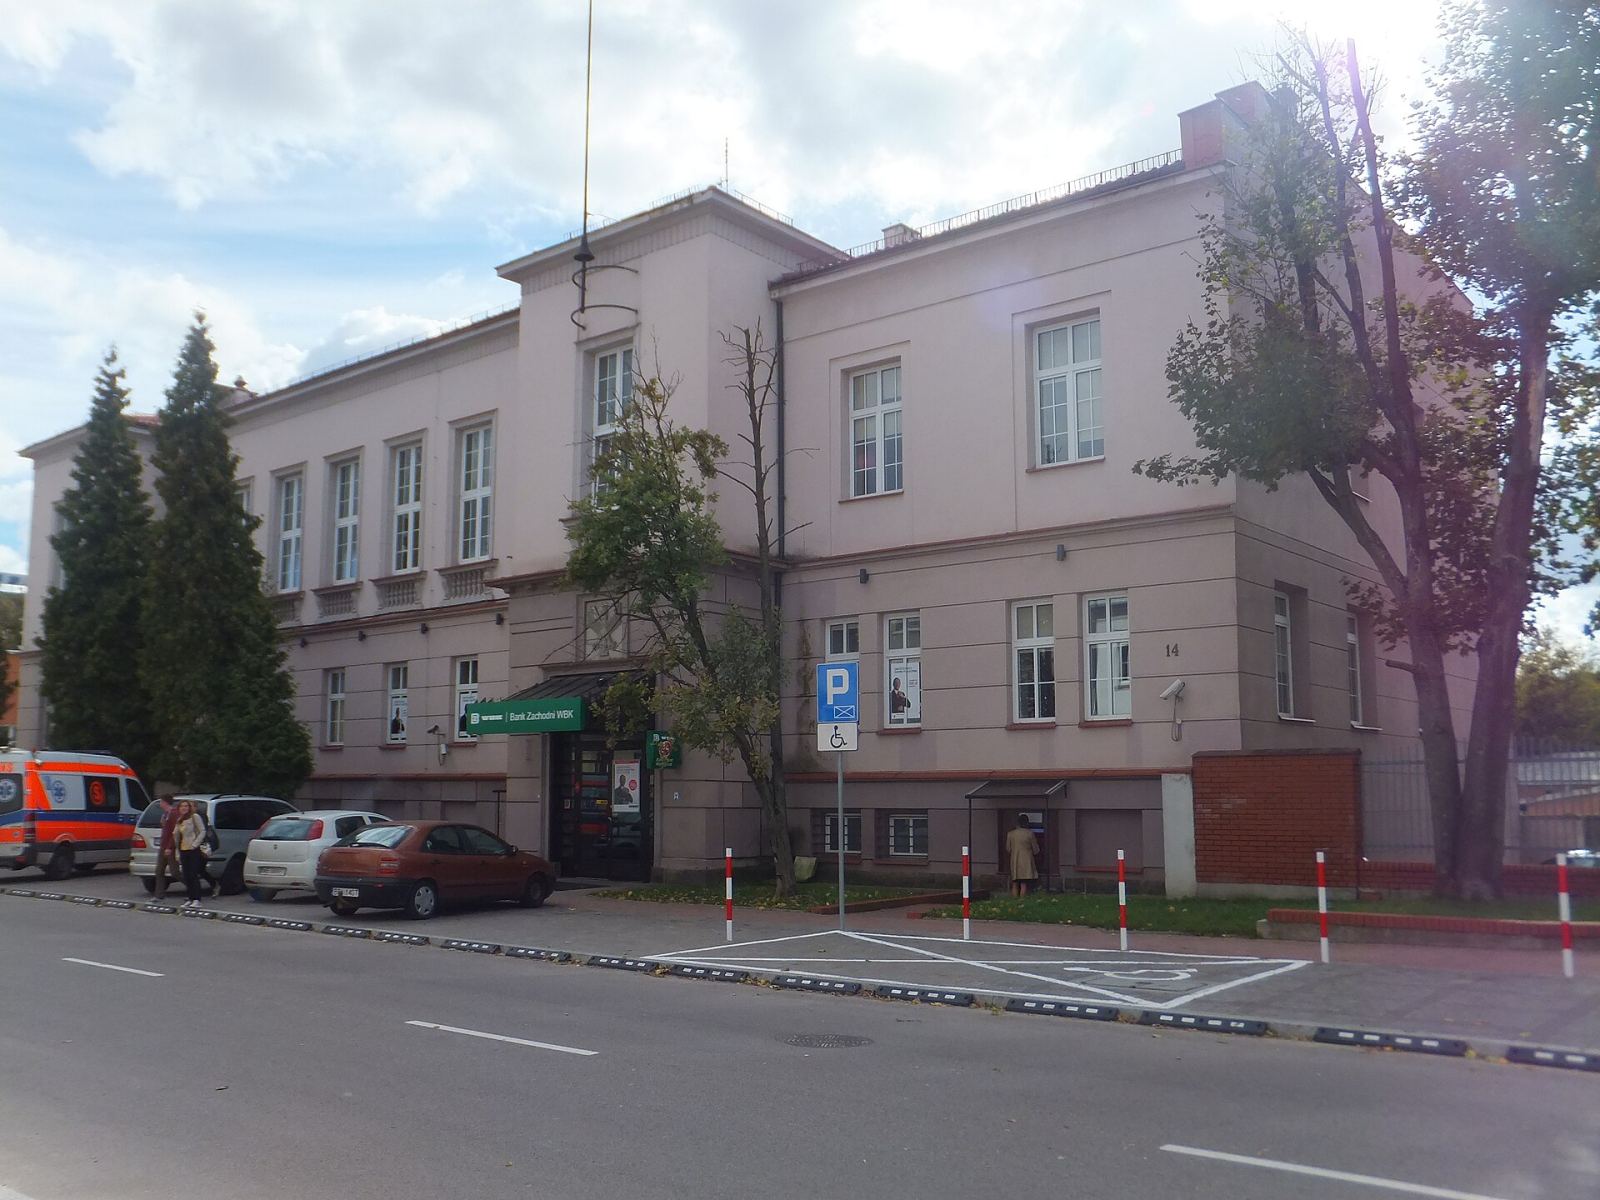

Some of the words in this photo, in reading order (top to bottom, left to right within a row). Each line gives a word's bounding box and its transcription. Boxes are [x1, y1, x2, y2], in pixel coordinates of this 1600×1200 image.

[1166, 643, 1179, 657] 14
[826, 668, 849, 705] P
[509, 712, 526, 721] Bank
[526, 711, 556, 721] Zachodni
[556, 709, 574, 719] WBK
